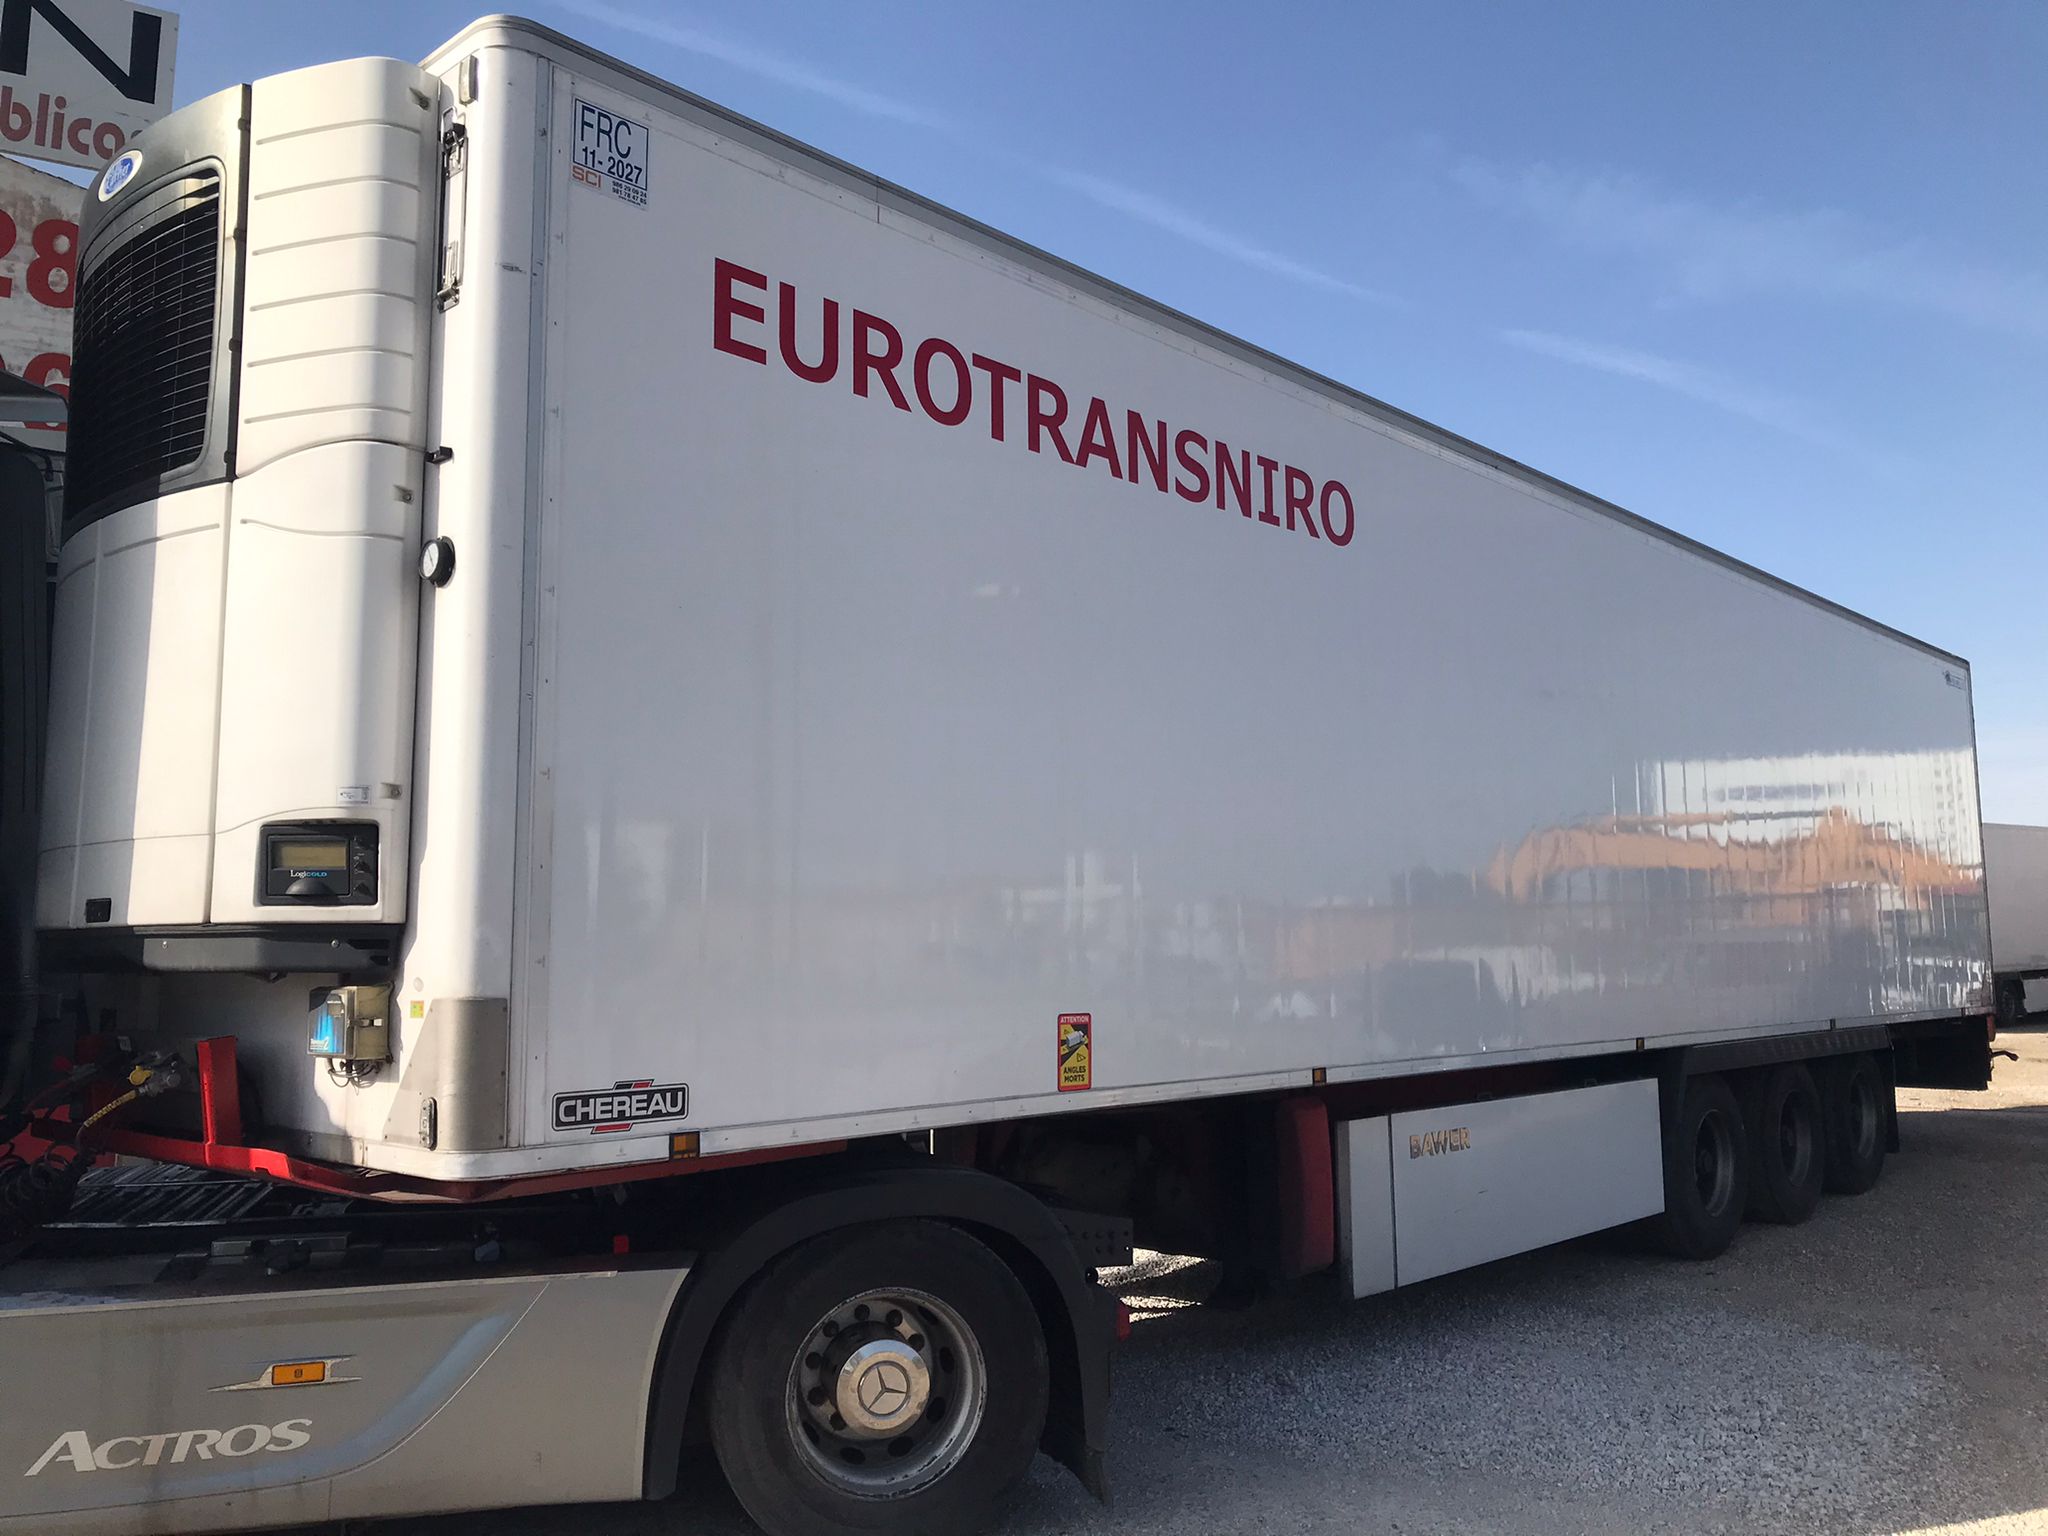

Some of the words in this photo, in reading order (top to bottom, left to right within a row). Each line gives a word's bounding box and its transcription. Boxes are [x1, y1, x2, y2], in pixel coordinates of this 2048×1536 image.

[581, 105, 631, 159] FRC
[572, 166, 601, 189] SCI
[714, 257, 1355, 547] EUROTRANSNIRO
[1064, 1066, 1086, 1074] ANGLES
[1064, 1074, 1085, 1083] MORTS
[559, 1091, 683, 1123] CHEREAU
[1409, 1127, 1471, 1160] BAWER
